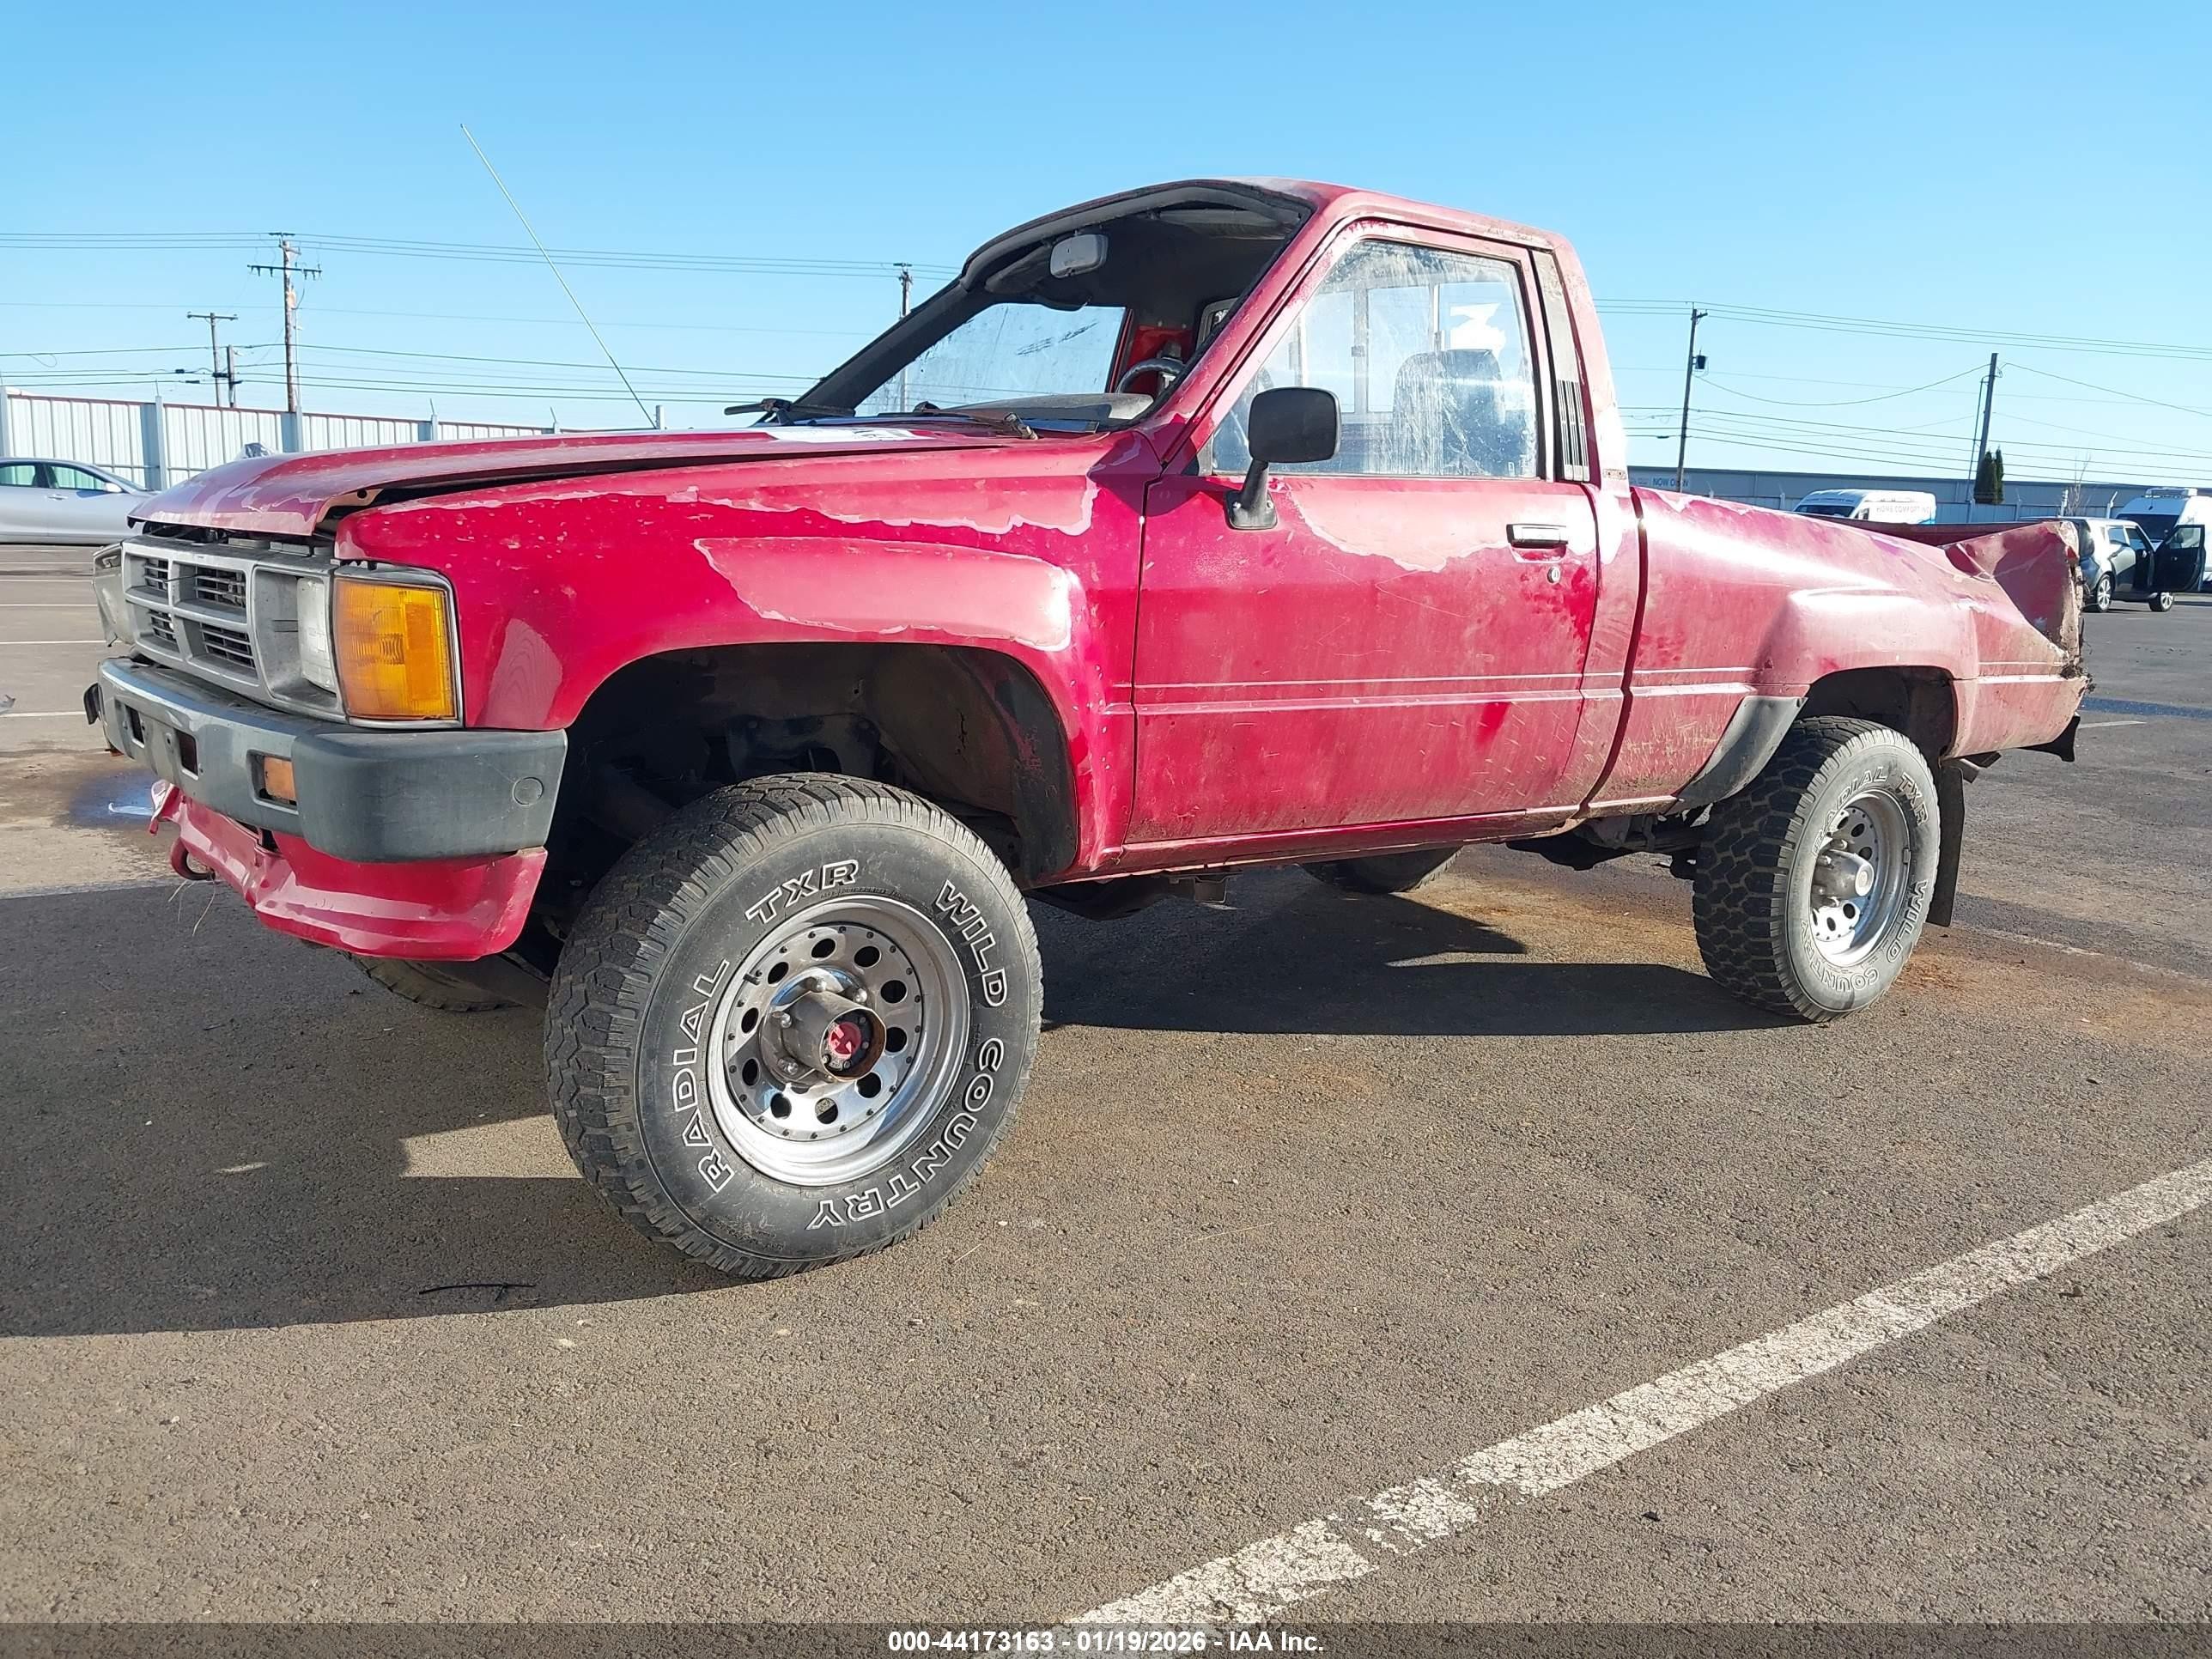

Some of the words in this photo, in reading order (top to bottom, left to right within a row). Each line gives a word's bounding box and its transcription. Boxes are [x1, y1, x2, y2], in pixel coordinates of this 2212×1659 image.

[1652, 477, 1668, 487] NOW
[1670, 478, 1689, 487] ON
[1895, 772, 1929, 827] TXR
[931, 878, 1008, 1008] WILD
[1801, 920, 1880, 993] COUNTRY
[1887, 879, 1929, 963] WILD
[672, 959, 736, 1194] RADIAL
[744, 860, 860, 925] TXR
[805, 1037, 1005, 1231] COUNTRY
